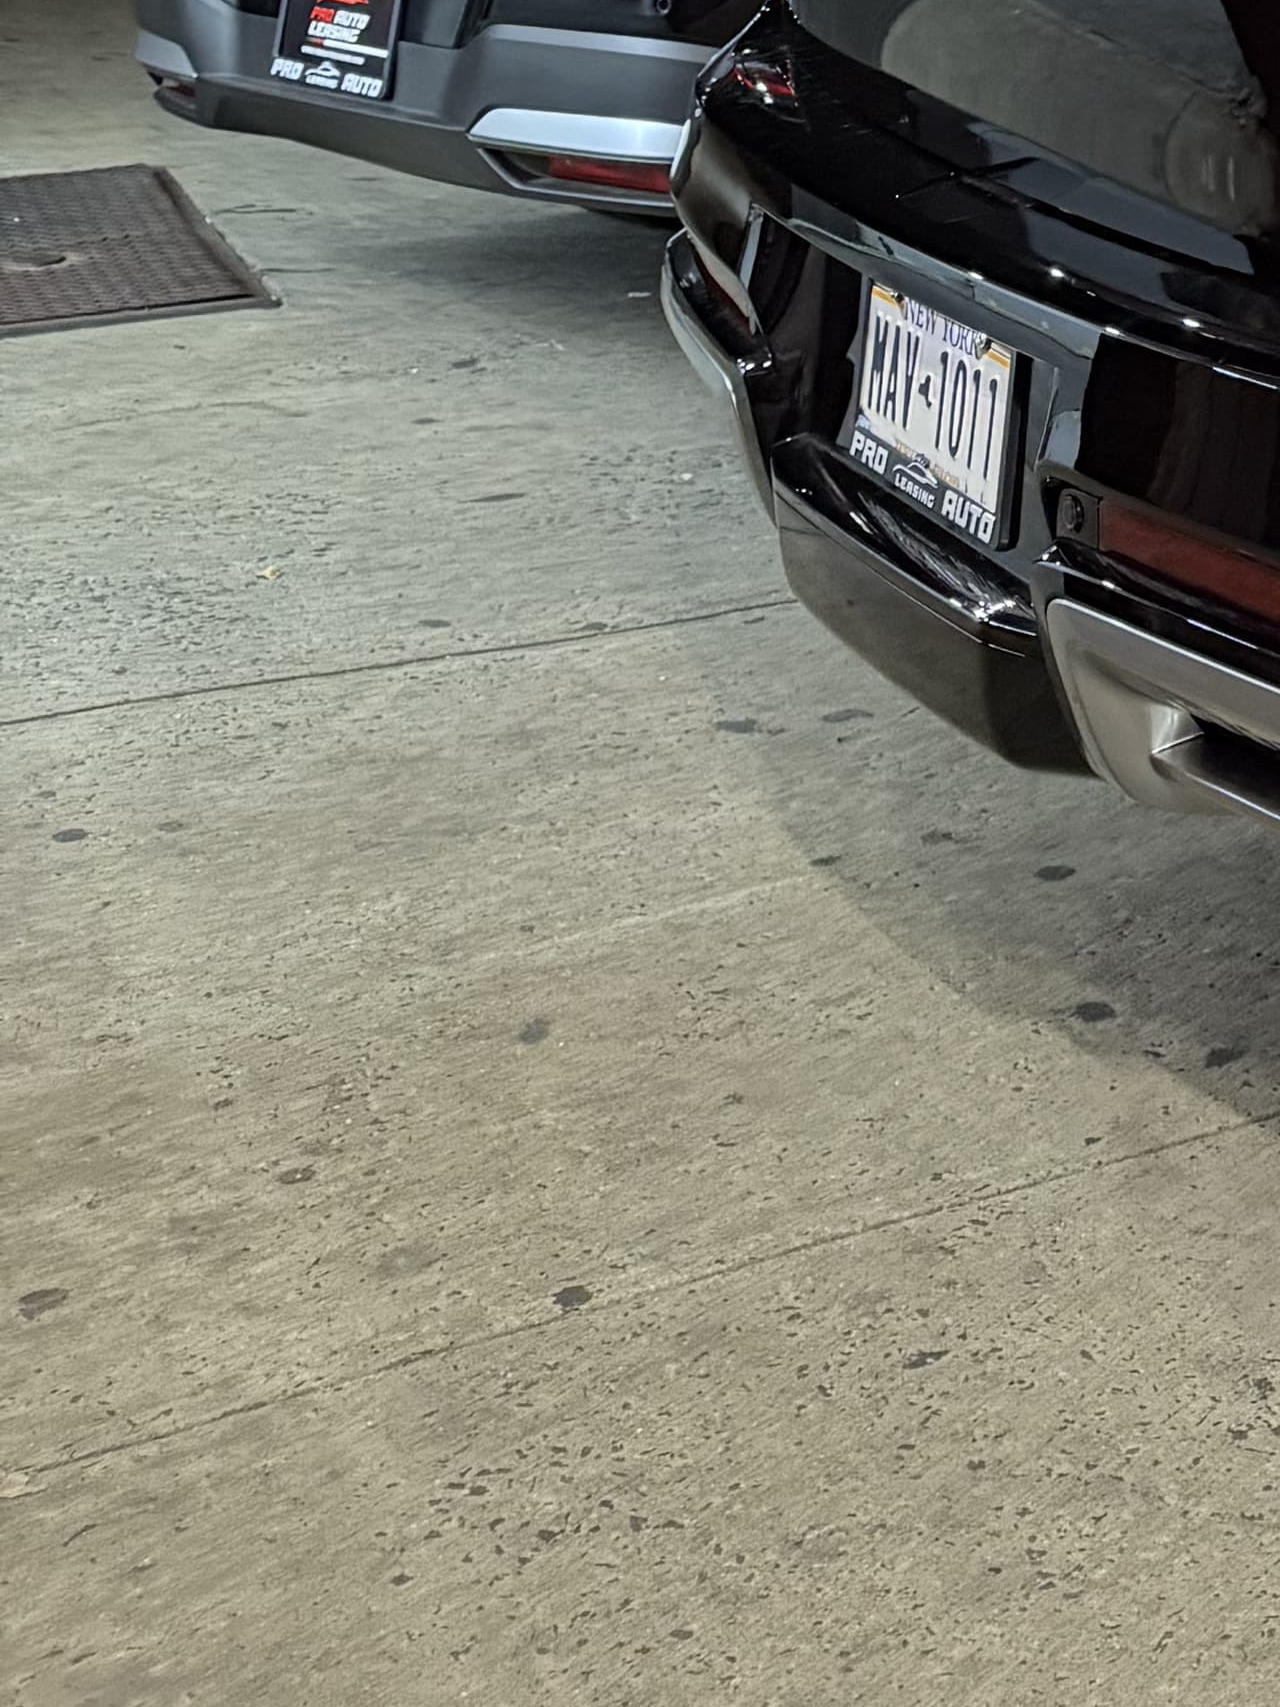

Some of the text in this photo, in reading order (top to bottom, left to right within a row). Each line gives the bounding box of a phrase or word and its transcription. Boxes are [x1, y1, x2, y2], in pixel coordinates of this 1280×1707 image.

[270, 58, 305, 81] PRO
[340, 72, 384, 99] AUTO
[903, 296, 938, 336] NEW
[934, 350, 1000, 482] 1011
[849, 430, 889, 475] PRO
[894, 473, 935, 509] LEASING
[940, 489, 997, 544] AUTO
